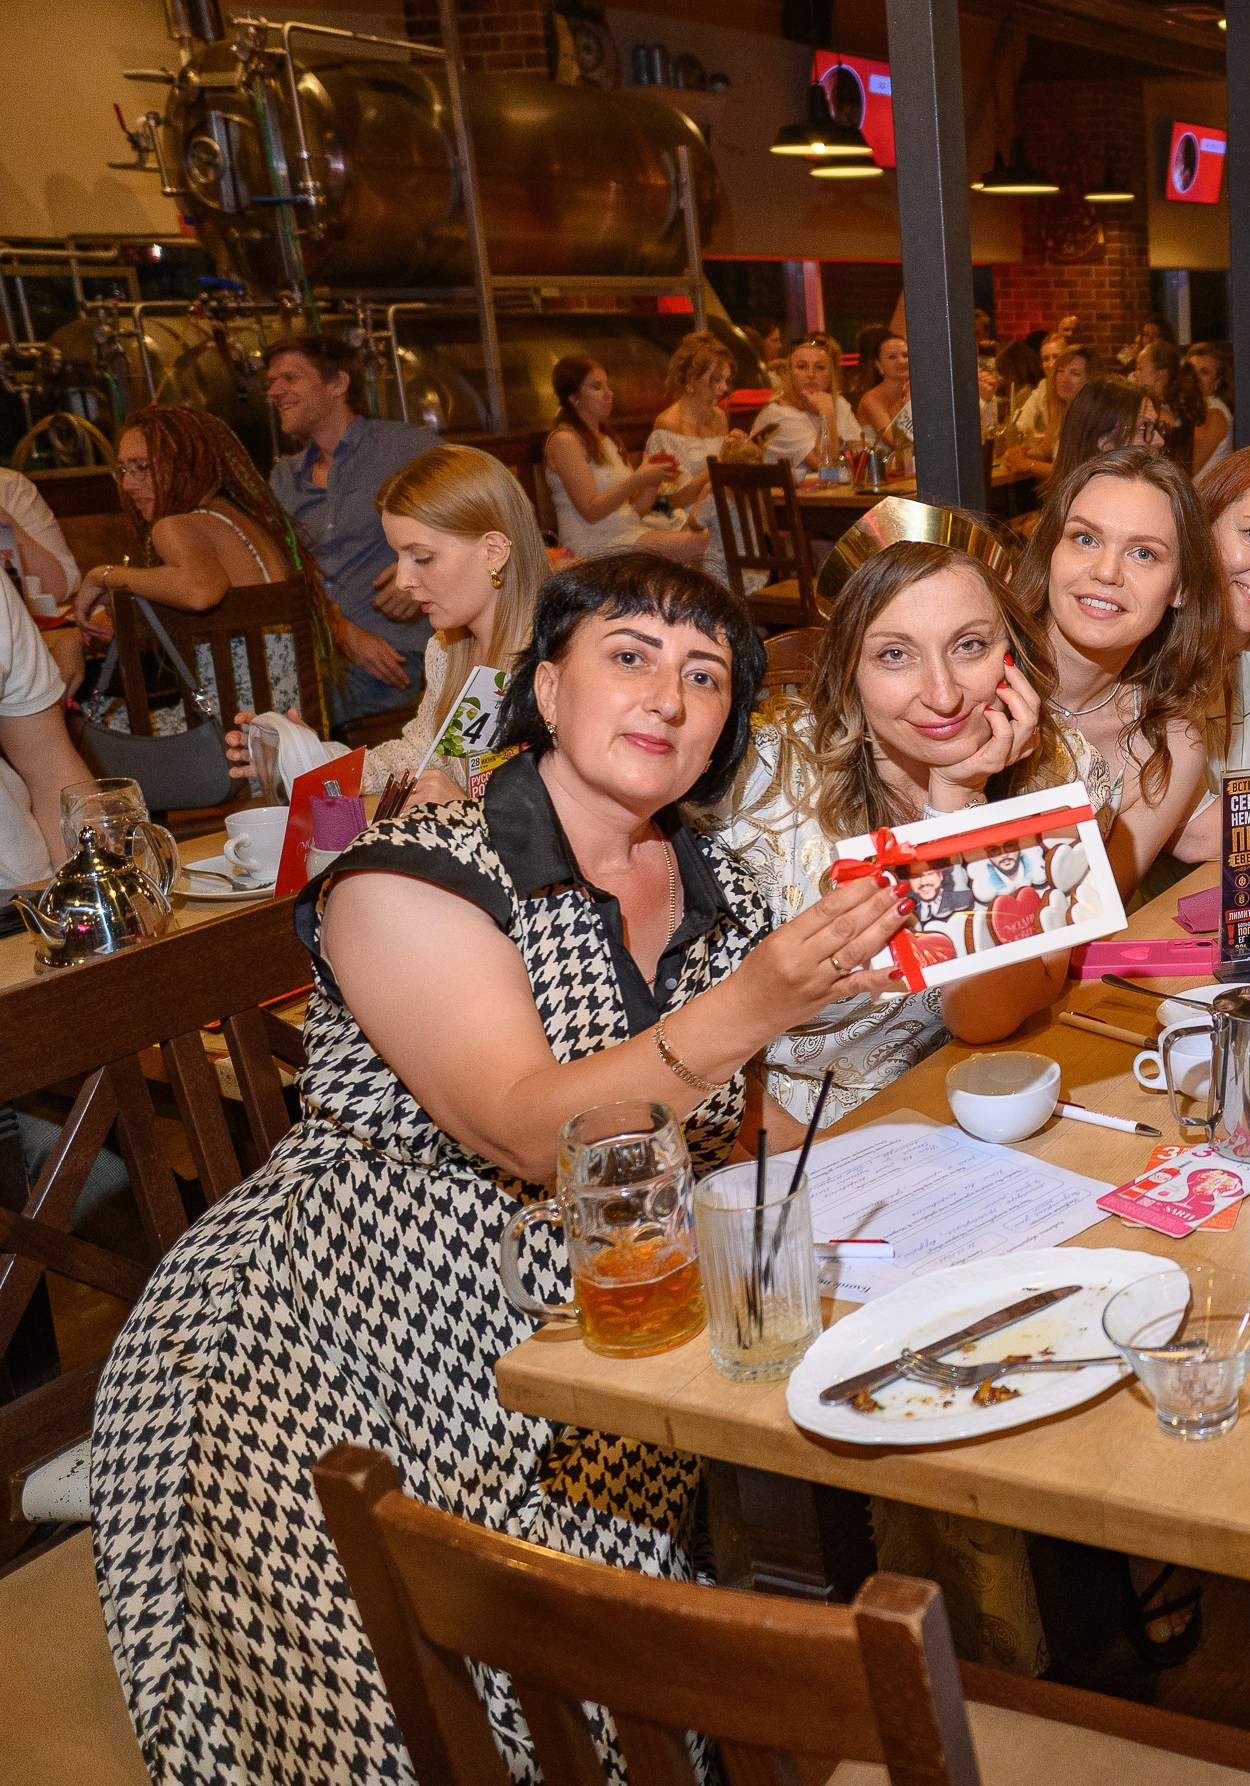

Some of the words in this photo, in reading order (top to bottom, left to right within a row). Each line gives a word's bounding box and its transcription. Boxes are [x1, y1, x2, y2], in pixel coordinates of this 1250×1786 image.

[471, 758, 480, 768] 28
[471, 770, 493, 787] РУСС
[472, 783, 486, 798] РО
[1157, 1146, 1180, 1160] 3
[1163, 1205, 1196, 1221] SARTI
